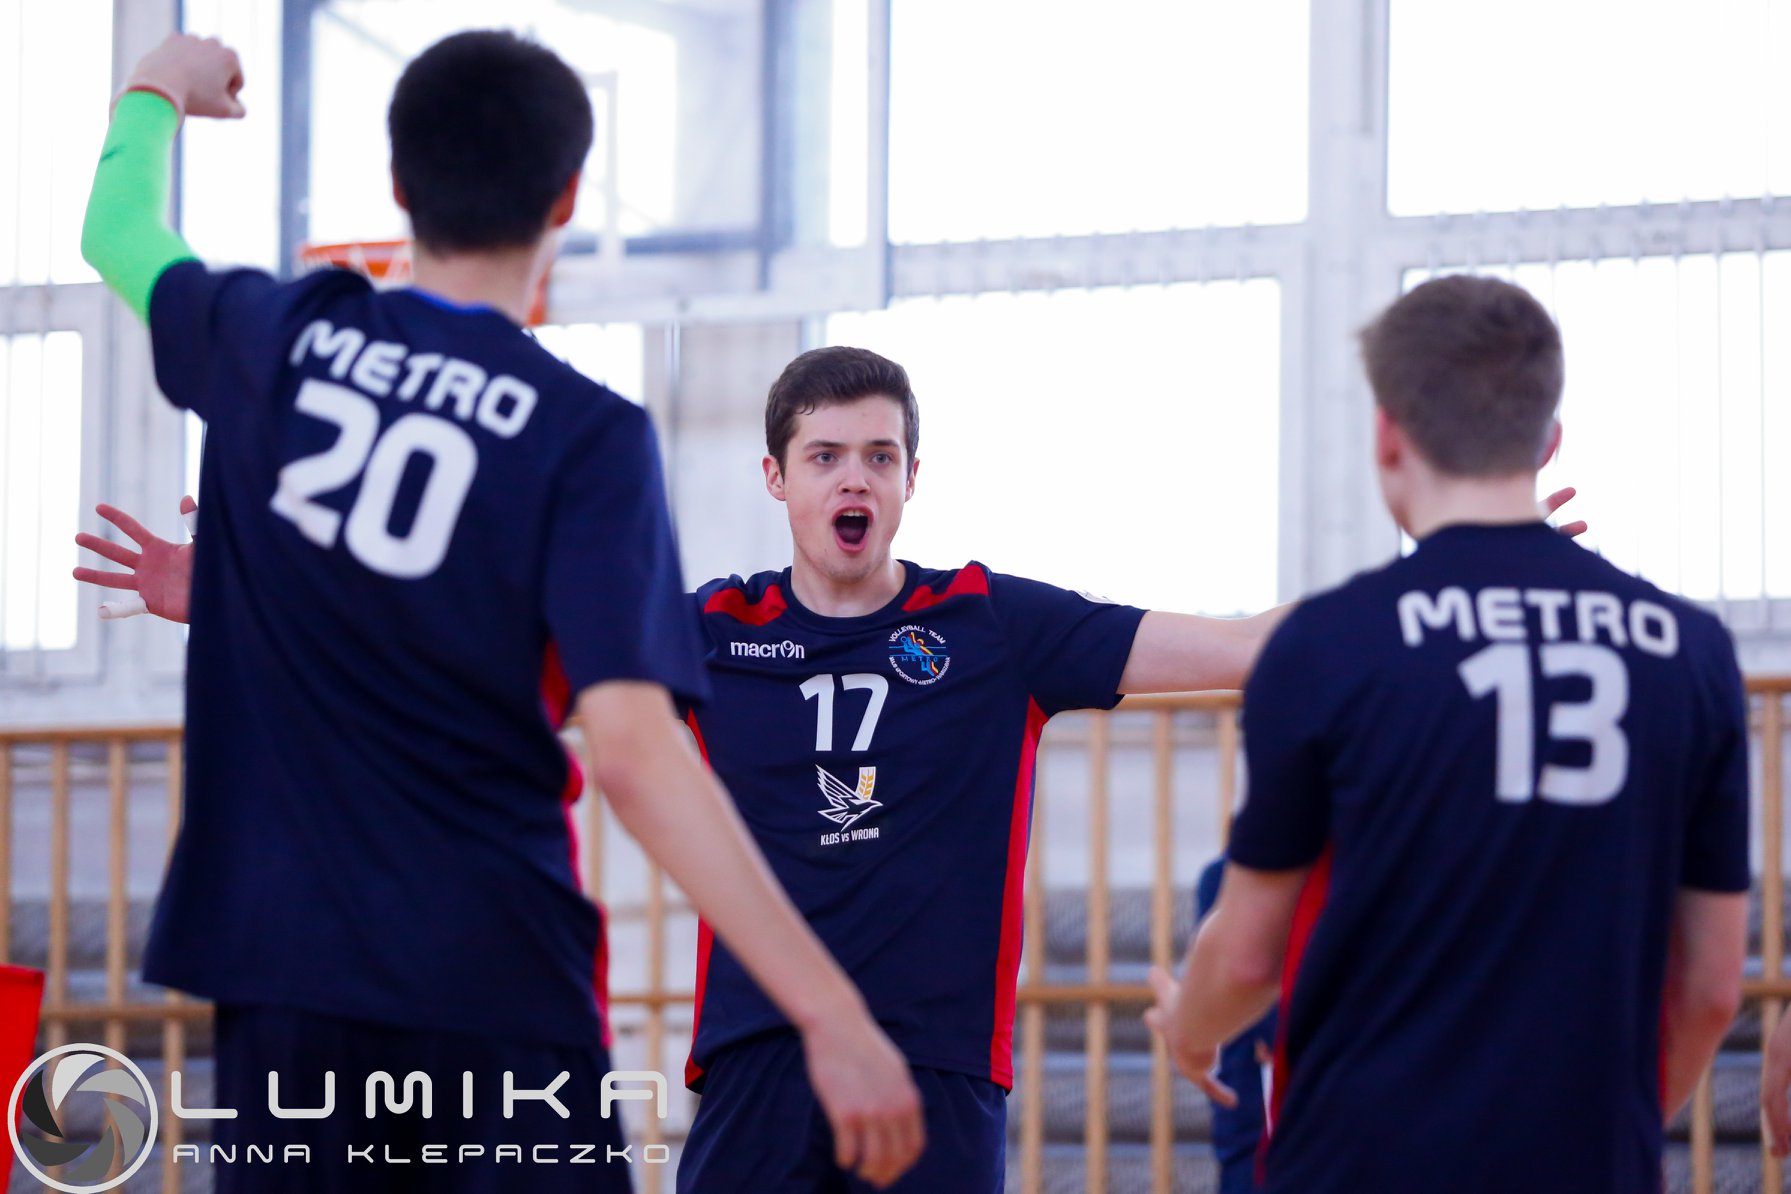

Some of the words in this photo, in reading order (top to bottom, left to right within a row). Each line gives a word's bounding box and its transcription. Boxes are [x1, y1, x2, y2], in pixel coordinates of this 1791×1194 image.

[290, 319, 539, 439] METRO
[269, 377, 479, 580] 20
[730, 640, 805, 659] macron
[889, 625, 926, 642] VOLLEYBALL
[928, 629, 946, 645] TEAM
[1398, 586, 1680, 659] METRO
[798, 673, 889, 751] 17
[1457, 640, 1630, 806] 13
[820, 832, 840, 846] KŁOS
[851, 827, 879, 841] WRONA
